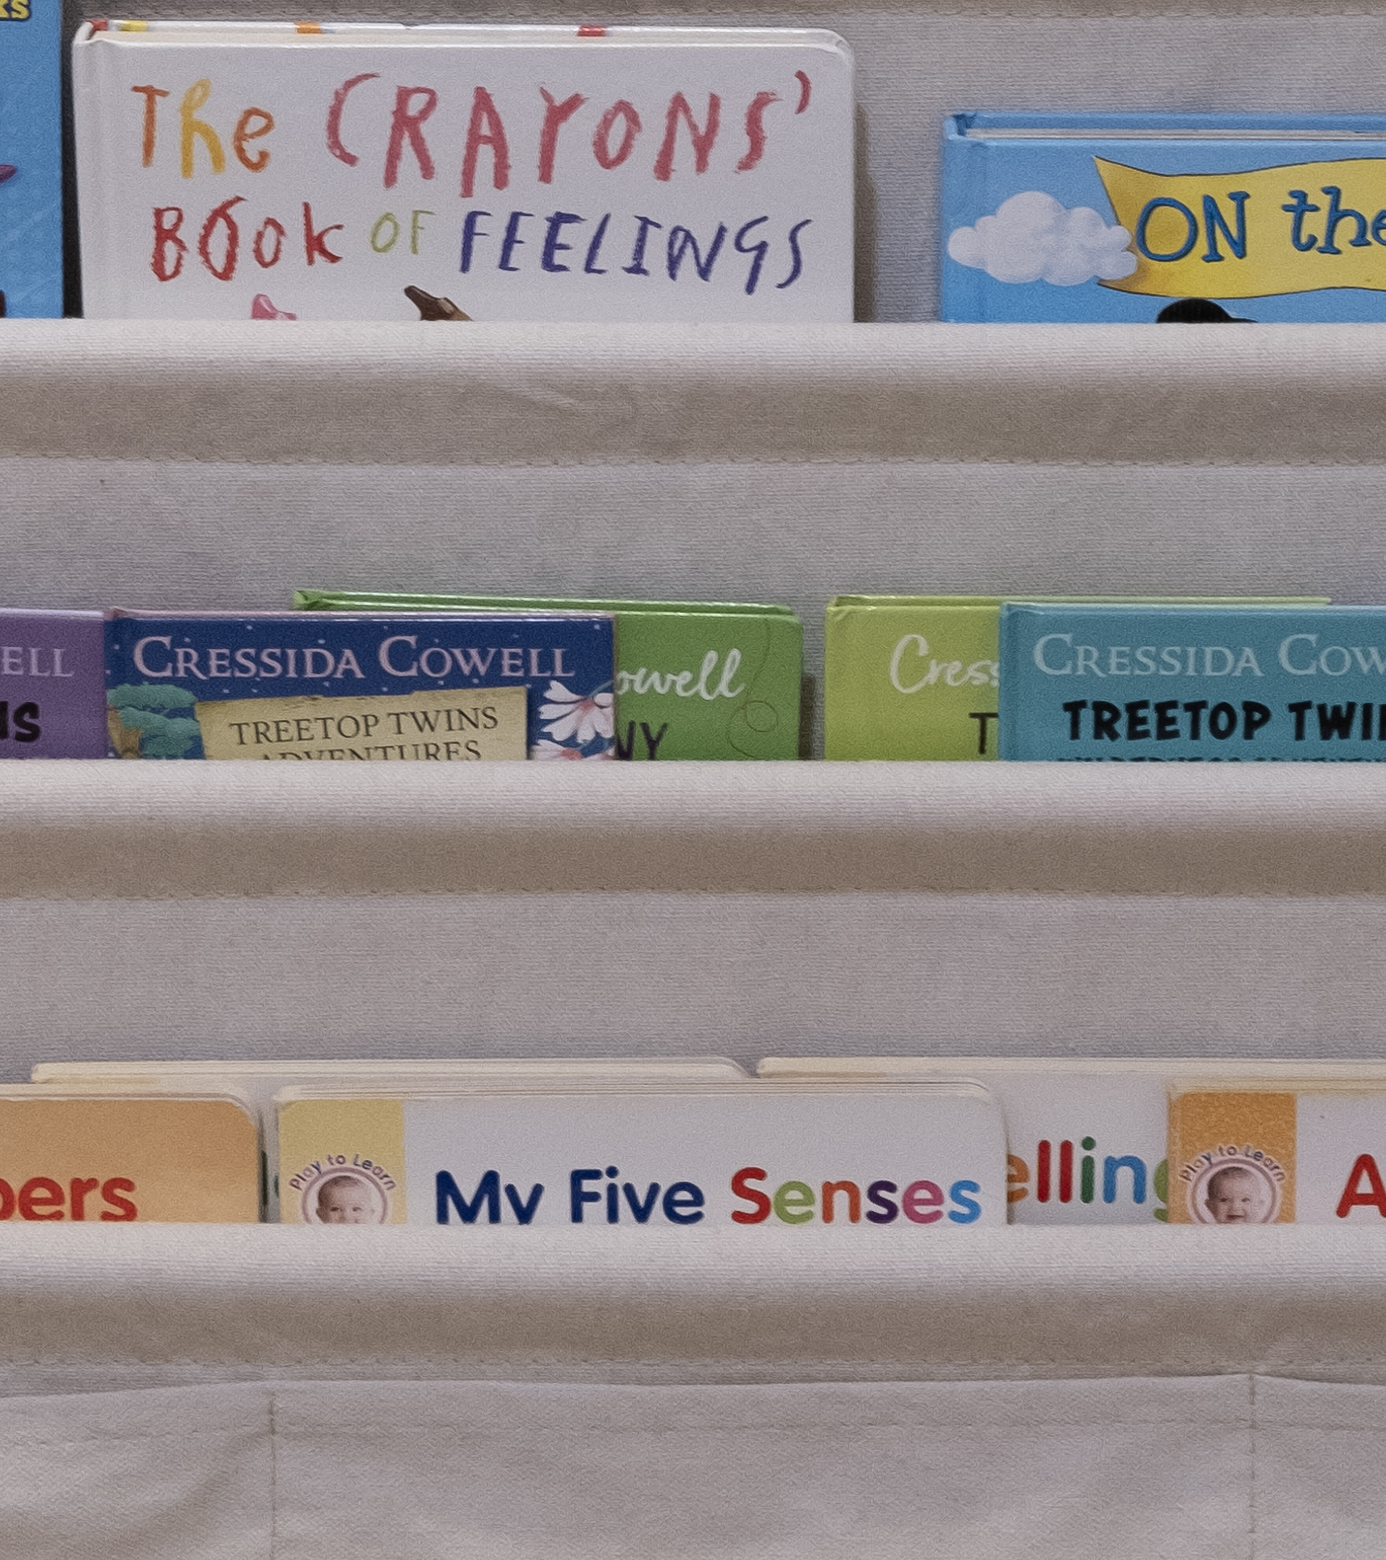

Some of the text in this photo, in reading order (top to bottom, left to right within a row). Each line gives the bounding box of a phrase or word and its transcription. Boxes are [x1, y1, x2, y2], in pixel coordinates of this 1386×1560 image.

[131, 78, 275, 179] The
[1134, 190, 1249, 263] ON
[459, 208, 813, 295] FEELINGS
[132, 634, 575, 679] CRESSIDA COWELL
[1033, 632, 1263, 679] CRESSIDA
[229, 706, 499, 746] TREETOP TWINS
[1063, 699, 1272, 742] TREETOP
[289, 1153, 395, 1192] Play to Learn
[1179, 1144, 1286, 1184] Play to Learn
[570, 1166, 705, 1224] Five
[731, 1166, 981, 1225] Senses
